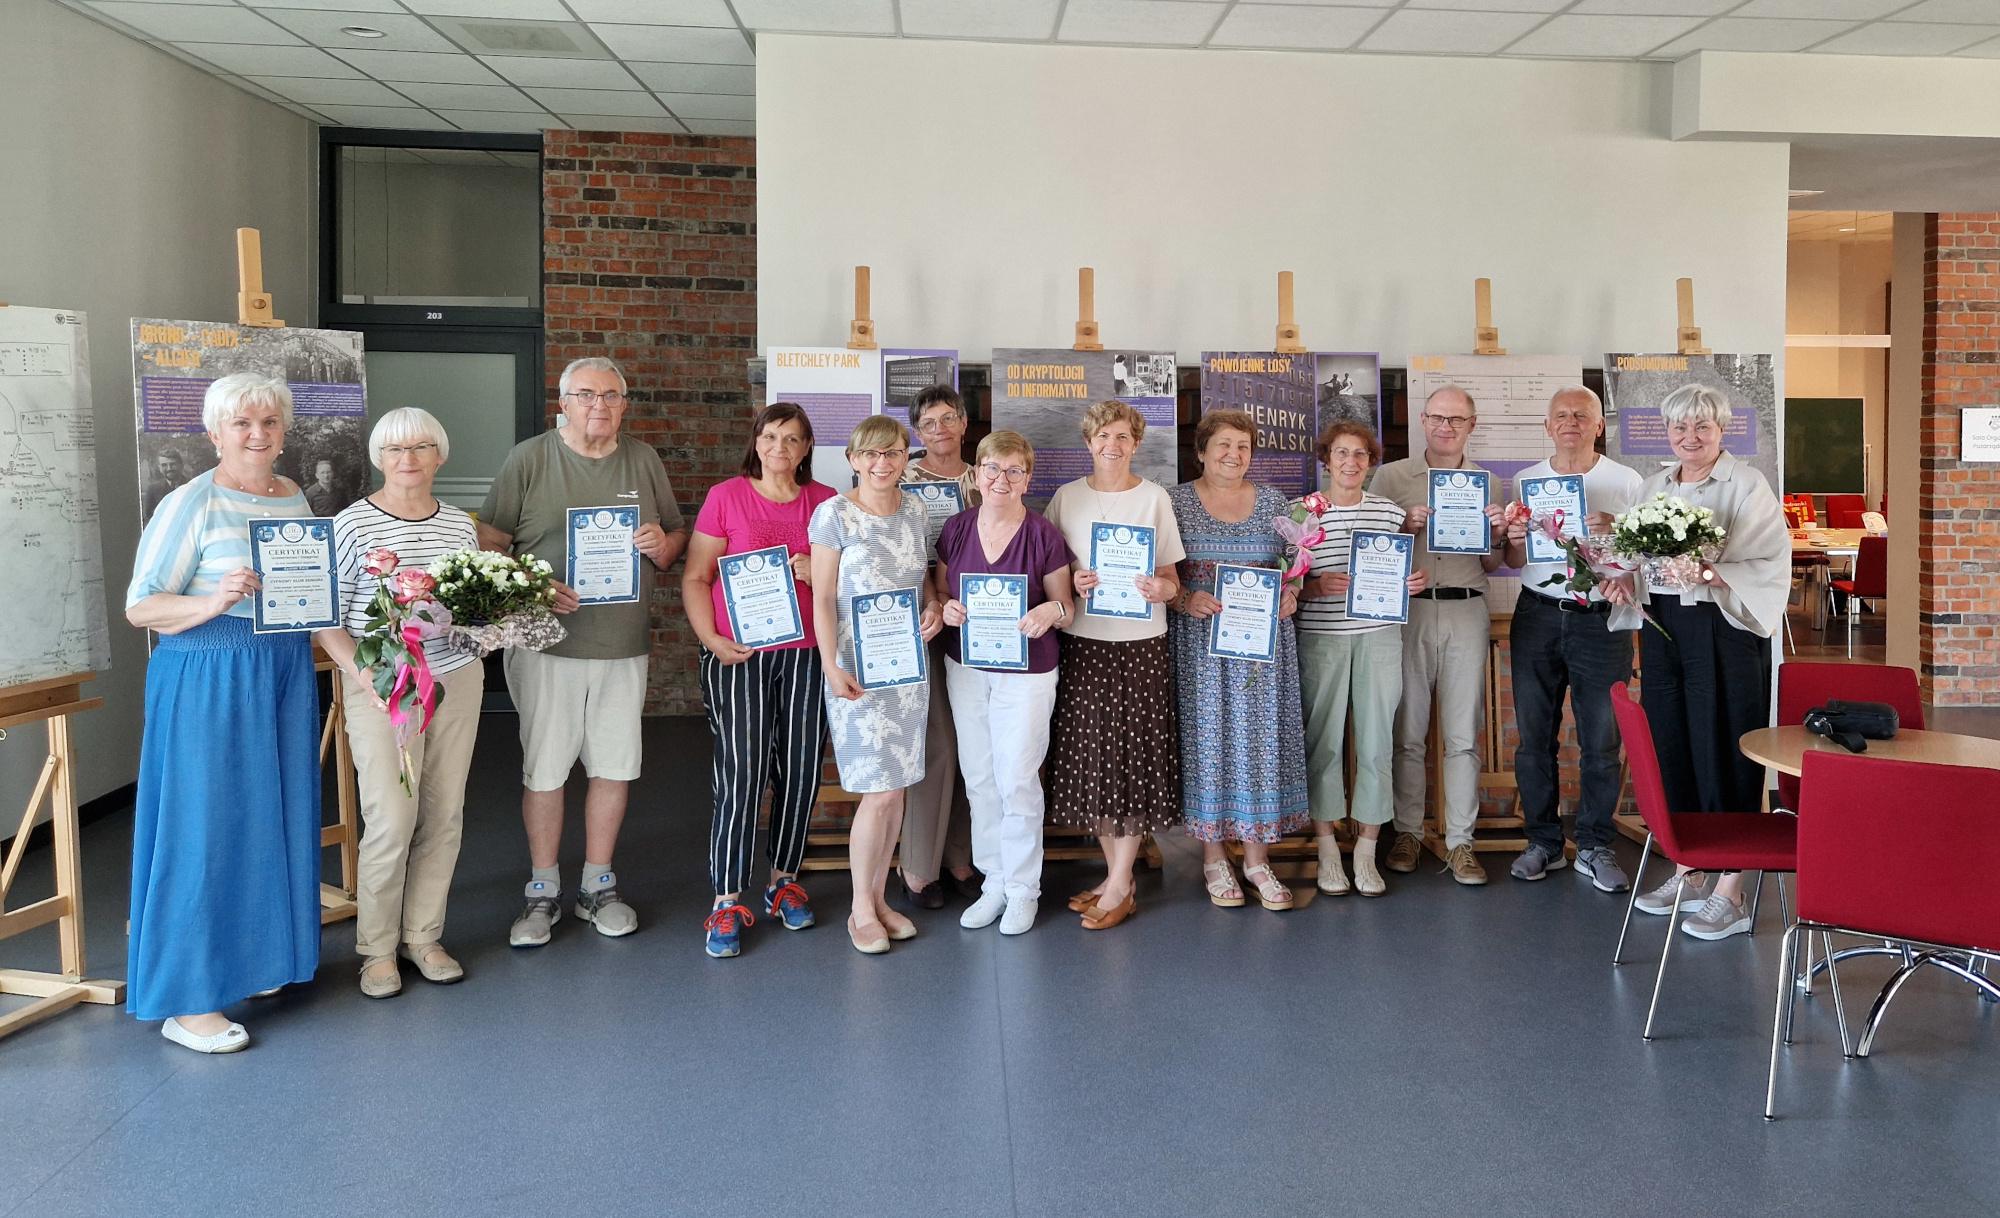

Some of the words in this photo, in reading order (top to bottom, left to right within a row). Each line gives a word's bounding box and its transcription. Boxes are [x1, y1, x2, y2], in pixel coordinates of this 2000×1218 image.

[426, 312, 443, 320] 203
[776, 352, 832, 368] BLETCHLEY
[834, 353, 861, 369] PARK
[1210, 358, 1265, 373] POWOJENNE
[1617, 356, 1689, 372] PODSUMOWANIE
[1007, 364, 1020, 380] OD
[1022, 364, 1085, 381] KRYPTOLOGII
[1007, 383, 1020, 398] DO
[1022, 383, 1088, 399] INFORMATYKI
[1243, 403, 1307, 430] HENRYK
[1256, 429, 1314, 453] GALSKI
[268, 548, 321, 557] CERTYFIKAT
